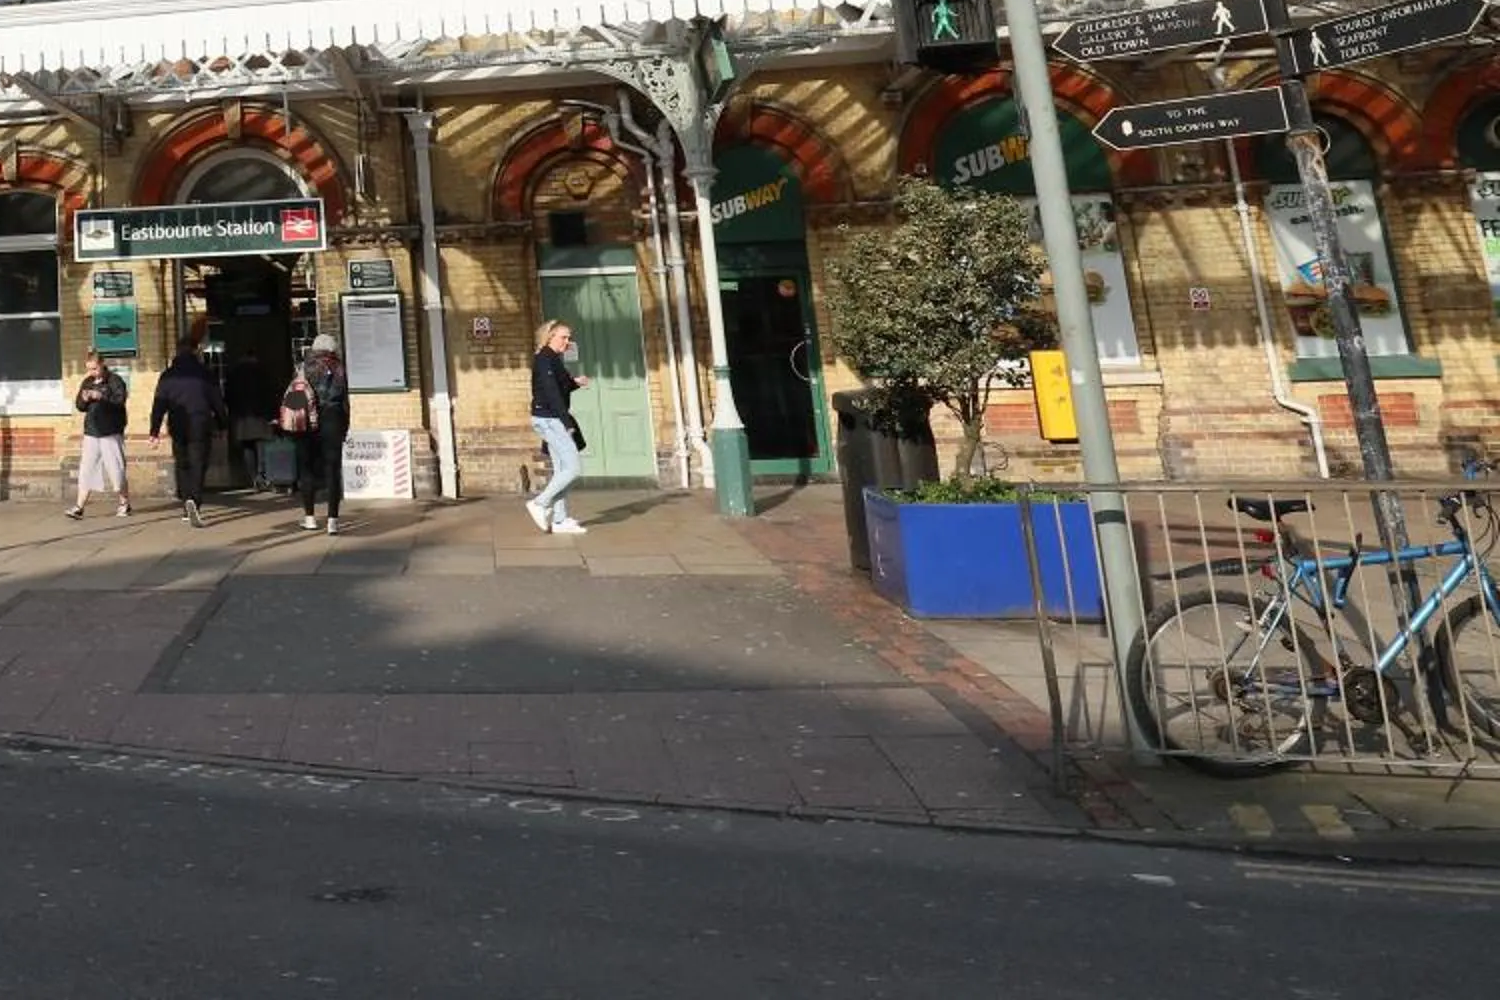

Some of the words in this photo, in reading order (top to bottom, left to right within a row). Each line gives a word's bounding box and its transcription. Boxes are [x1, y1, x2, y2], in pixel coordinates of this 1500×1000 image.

[1147, 9, 1180, 22] PARK
[1334, 14, 1376, 35] TOURIST
[1135, 27, 1145, 36] &
[1336, 24, 1389, 48] SEAFRONT
[1080, 46, 1105, 57] OLD
[1111, 37, 1150, 52] TOWN
[1339, 41, 1380, 60] TOILETS
[1166, 109, 1181, 119] TO
[1187, 106, 1207, 116] THE
[1137, 125, 1173, 138] SOUTH
[1175, 121, 1215, 133] DOWNS
[1217, 118, 1240, 128] WAY
[951, 135, 1030, 185] SUBW
[711, 177, 789, 224] SUBWAY
[121, 221, 213, 241] Eastbourne
[216, 217, 275, 238] Station
